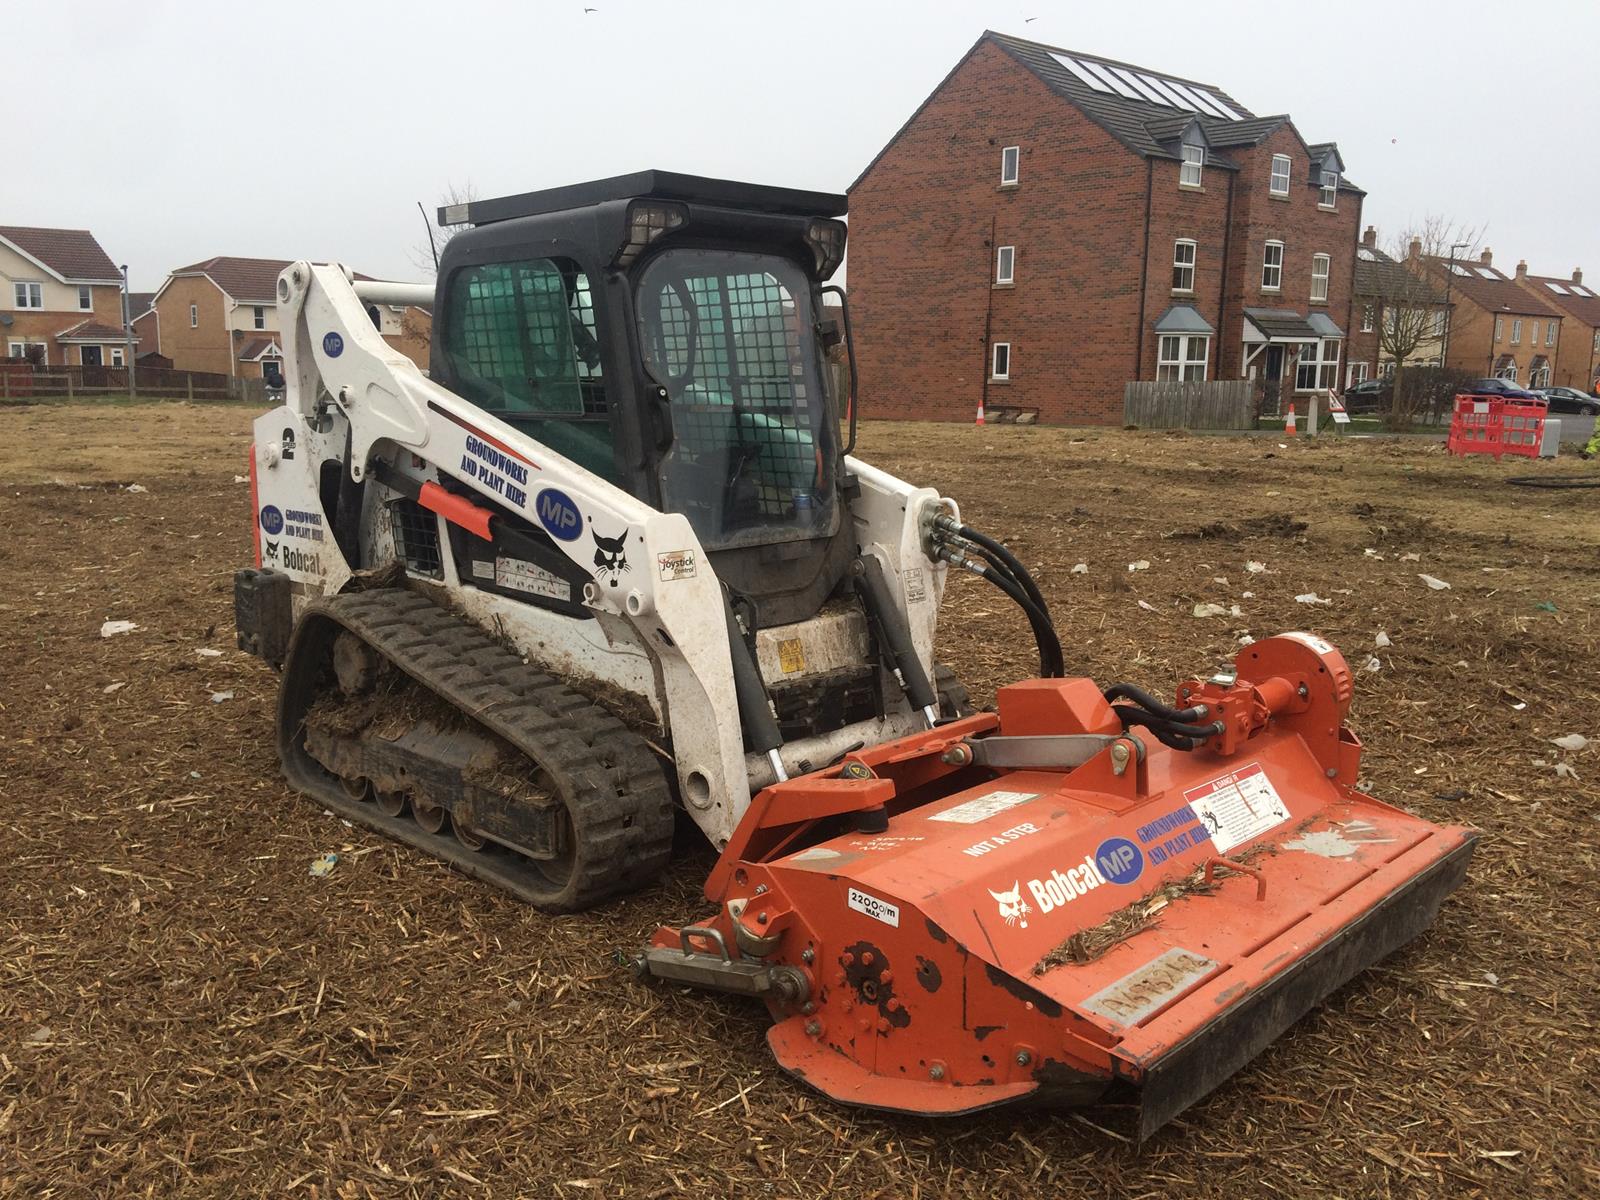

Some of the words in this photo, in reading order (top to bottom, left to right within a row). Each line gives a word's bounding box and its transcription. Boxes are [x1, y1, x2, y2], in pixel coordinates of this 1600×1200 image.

[282, 427, 295, 460] 2
[466, 435, 529, 486] GROUNDWORKS
[461, 455, 477, 477] AND
[478, 468, 505, 495] PLANT
[505, 483, 527, 509] HIRE
[262, 511, 281, 528] MP
[285, 509, 322, 526] GROUNDWORKS
[541, 495, 577, 529] MP
[285, 525, 295, 536] AND
[295, 526, 311, 541] PLANT
[312, 529, 324, 543] HIRE
[283, 545, 321, 575] Bobcat
[962, 840, 997, 857] NOT
[991, 836, 1011, 845] A
[1001, 823, 1039, 840] STEP
[1147, 846, 1168, 867] AND
[1164, 832, 1192, 857] PLANT
[1099, 845, 1135, 879] MP
[1027, 855, 1106, 914] Bobcat
[865, 908, 881, 919] MAX
